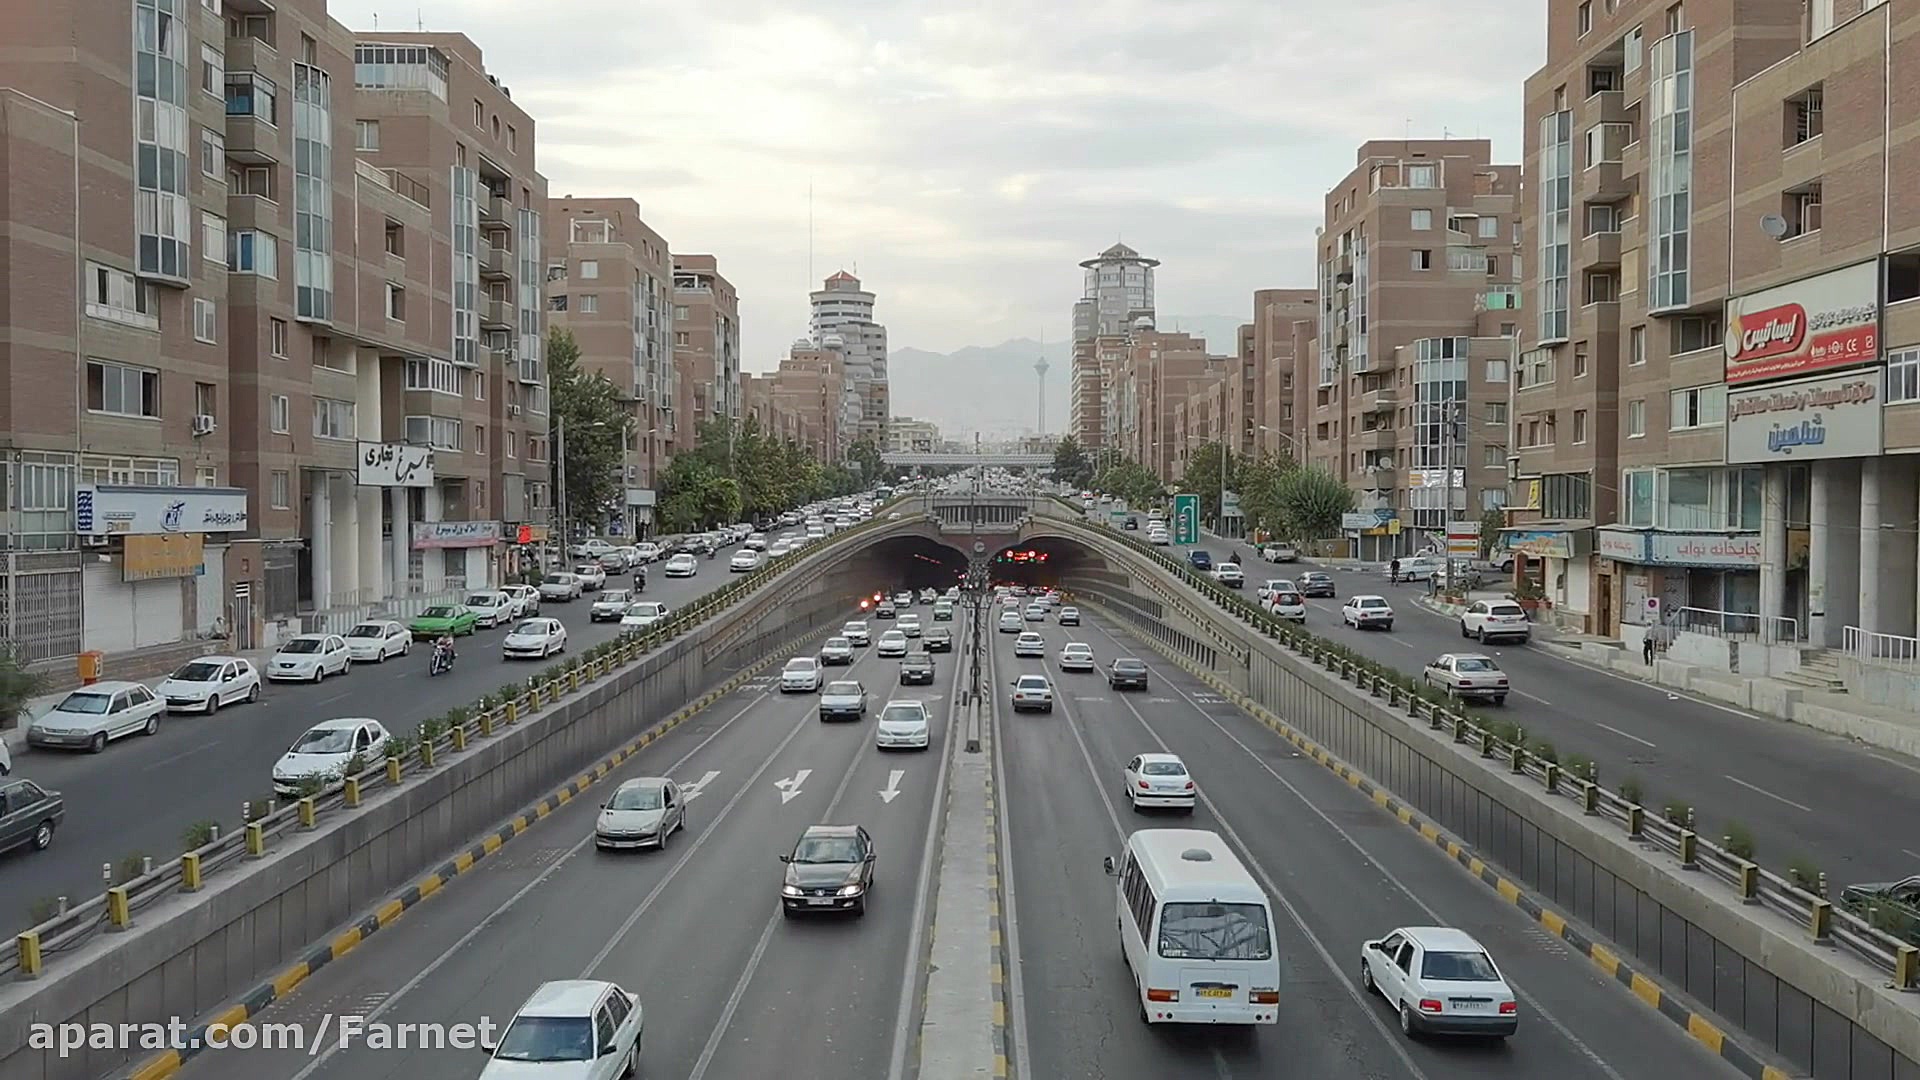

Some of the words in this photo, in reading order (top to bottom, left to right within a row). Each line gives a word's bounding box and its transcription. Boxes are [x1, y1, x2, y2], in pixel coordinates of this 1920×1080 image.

[1742, 313, 1798, 351] ایساتیس
[1768, 413, 1826, 455] شاهین
[365, 444, 393, 471] تجاری
